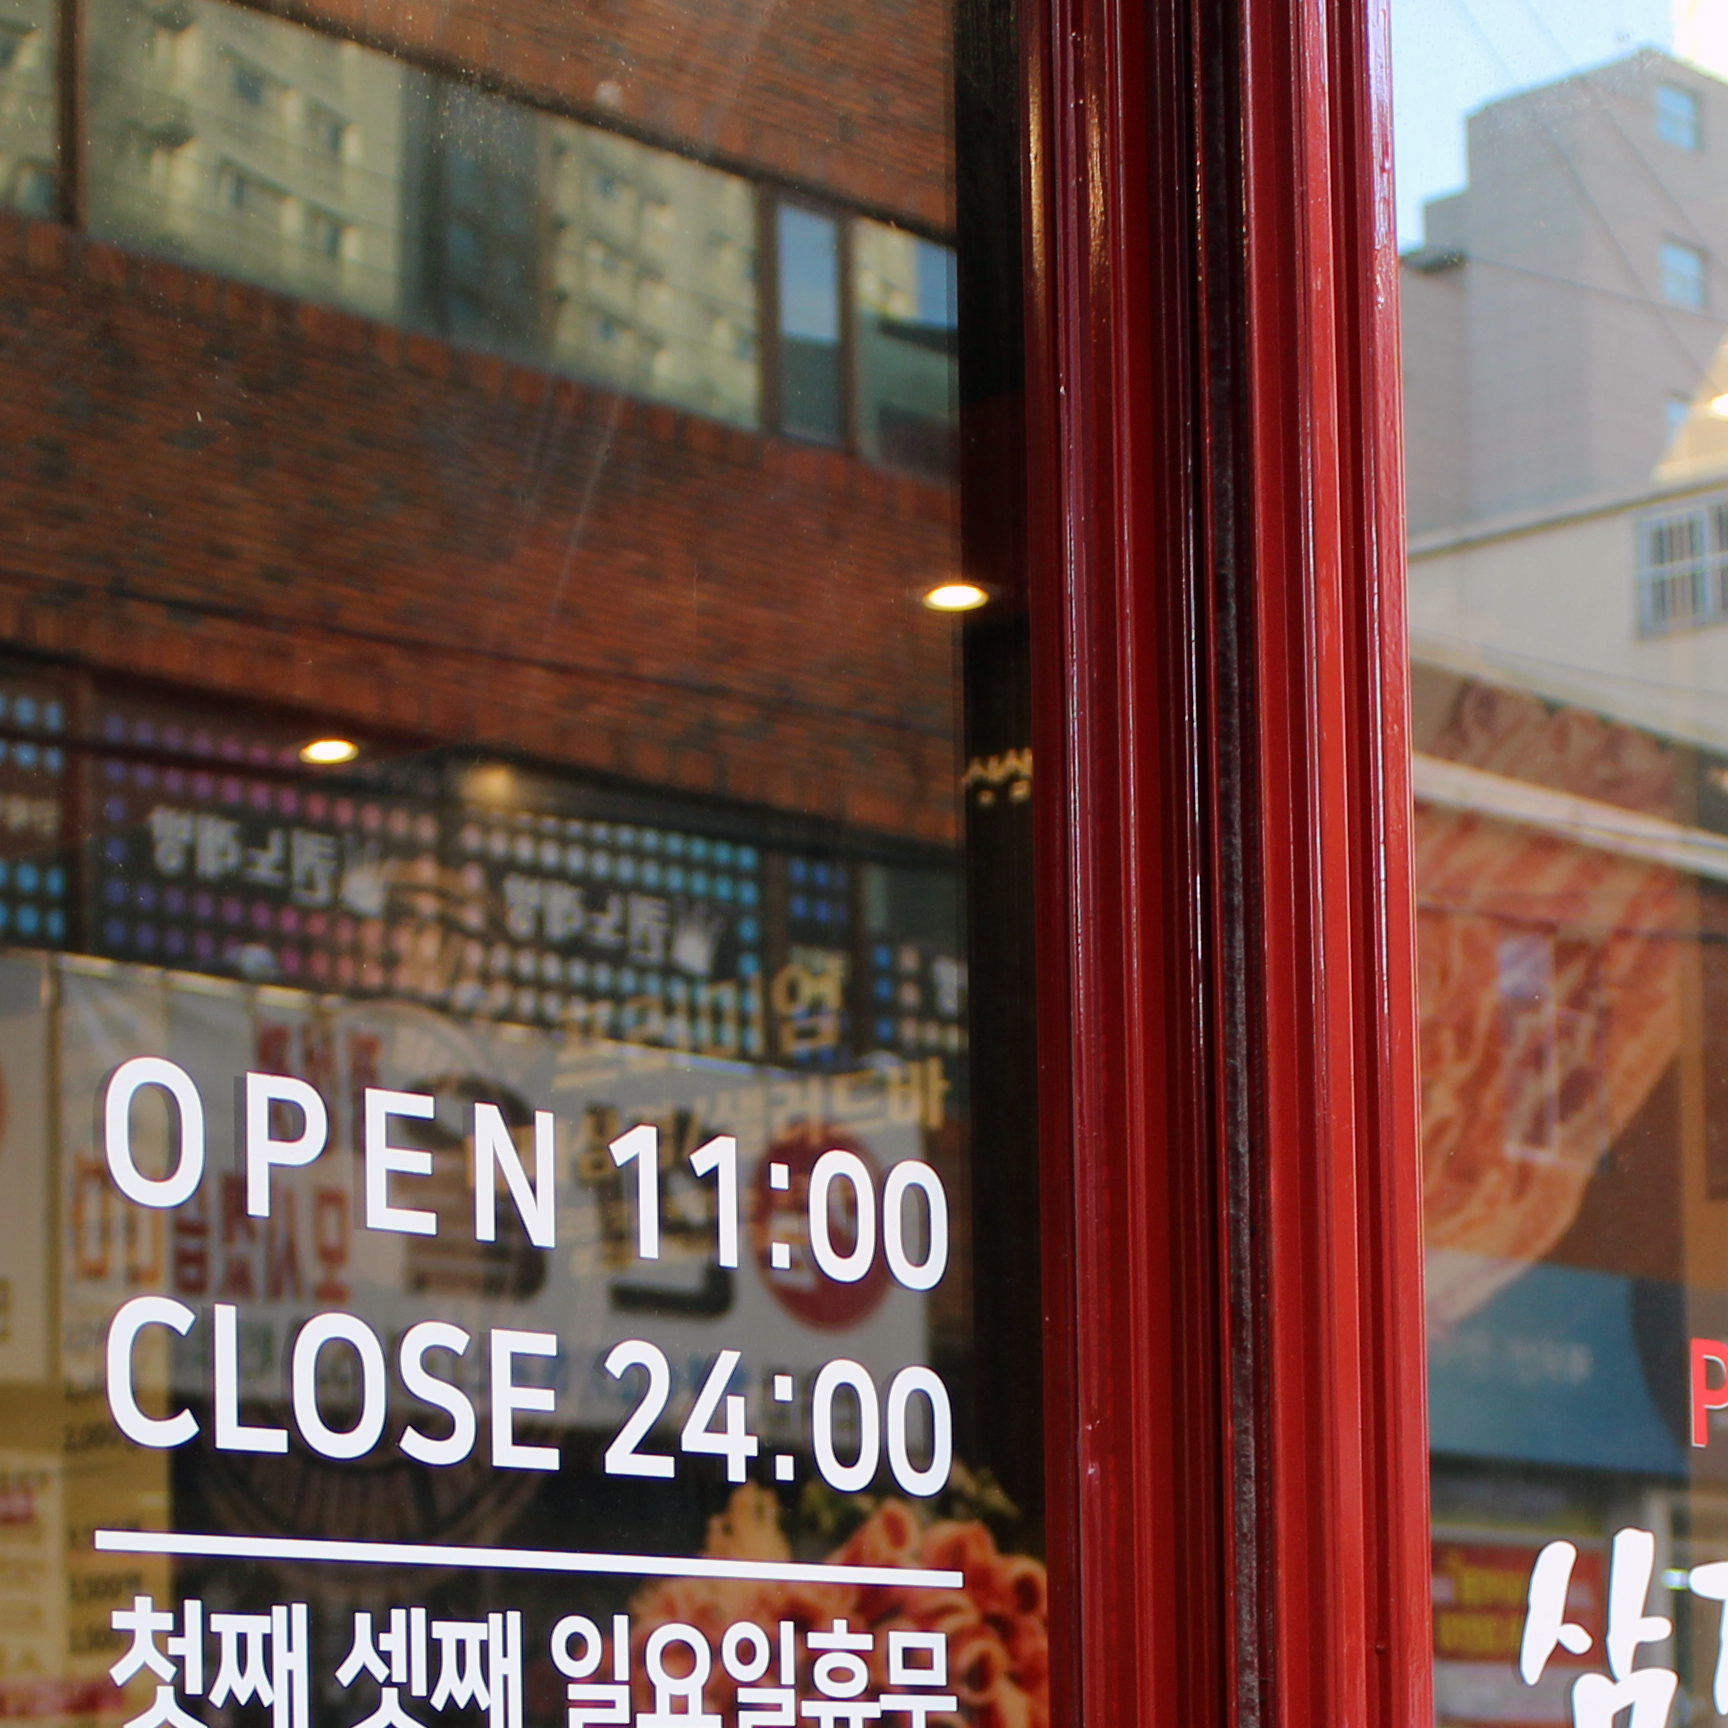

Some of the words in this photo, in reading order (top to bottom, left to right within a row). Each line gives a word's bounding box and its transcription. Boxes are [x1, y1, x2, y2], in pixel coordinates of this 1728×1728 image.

[104, 1056, 556, 1249] OPEN
[608, 1124, 949, 1291] 11:00
[106, 1295, 560, 1471] CLOSE
[604, 1339, 953, 1497] 24:00
